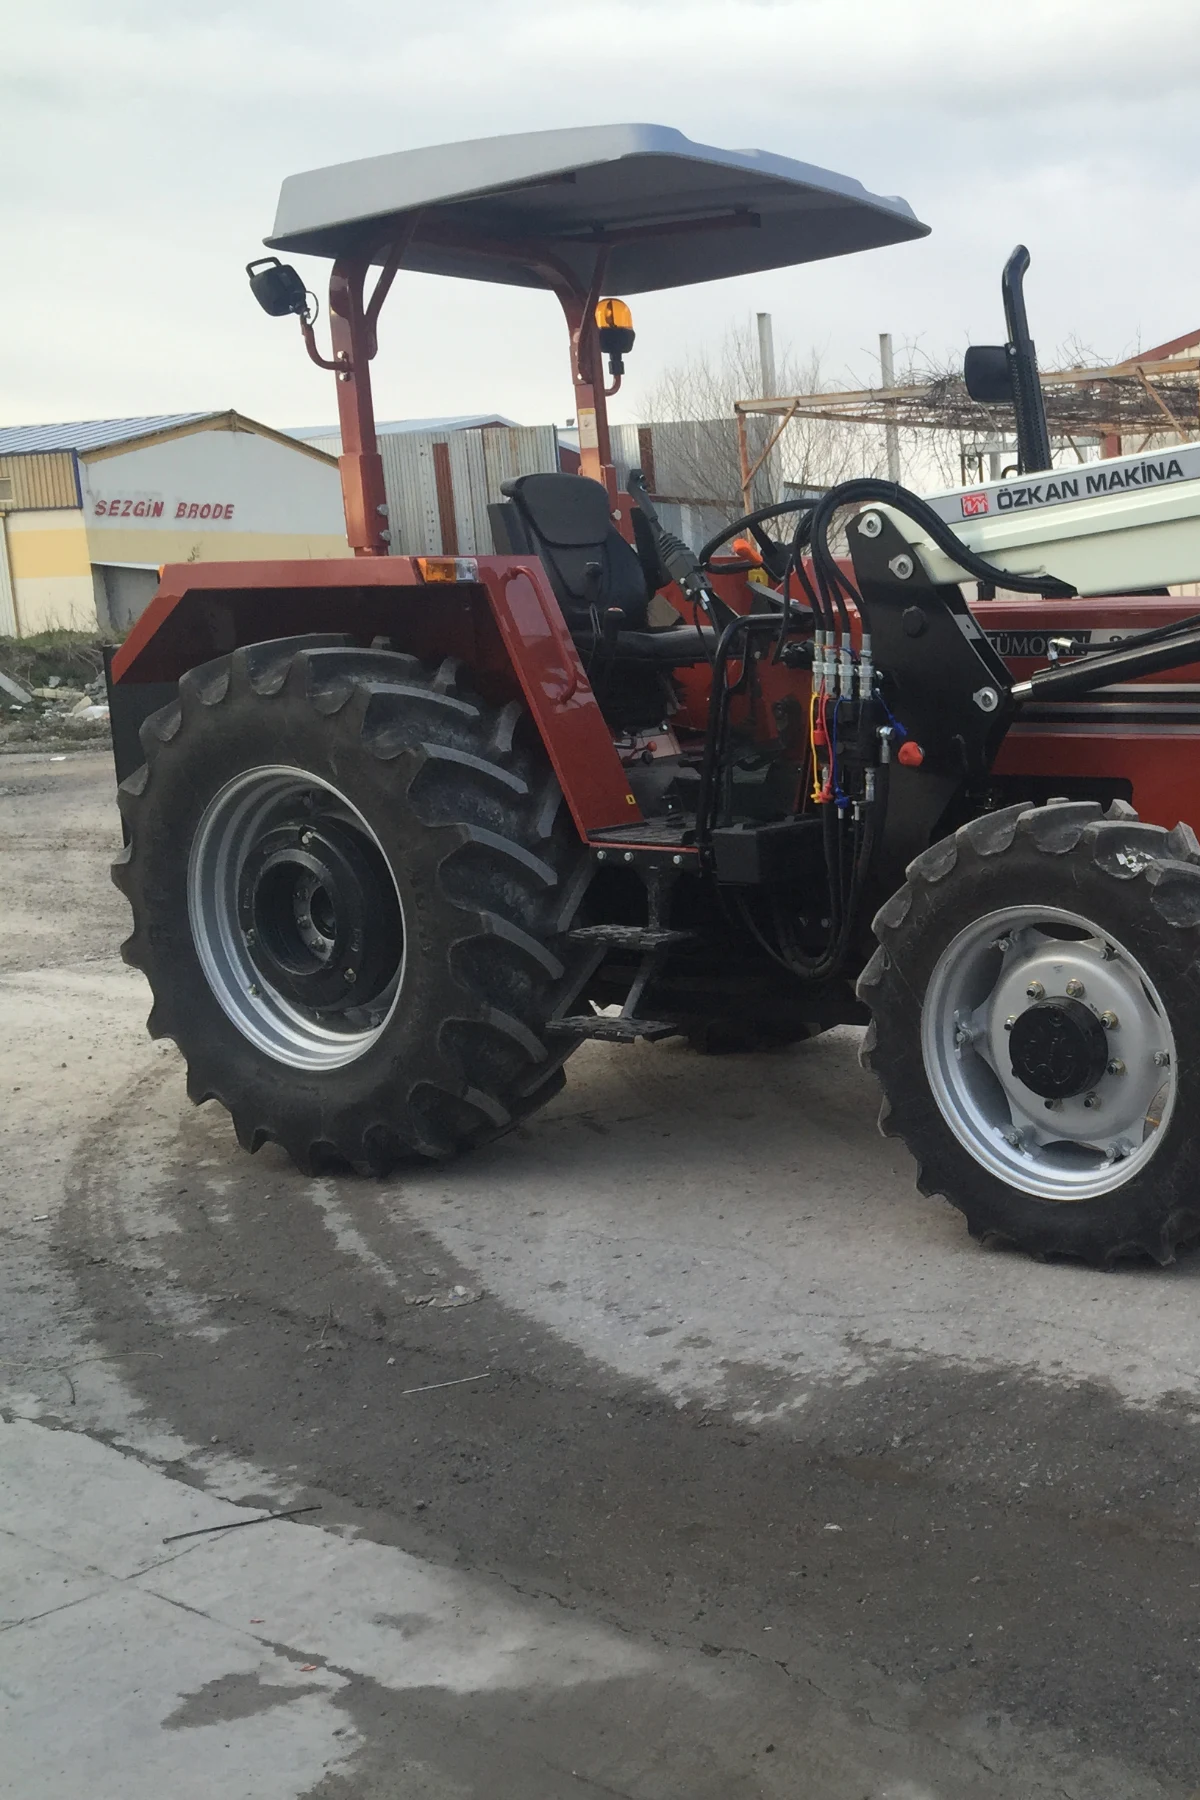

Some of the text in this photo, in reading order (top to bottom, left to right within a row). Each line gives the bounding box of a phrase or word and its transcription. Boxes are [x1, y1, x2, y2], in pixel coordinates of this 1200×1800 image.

[997, 478, 1079, 510] ÖZKAN
[1086, 459, 1184, 494] MAKİNA
[174, 502, 235, 519] BRODE
